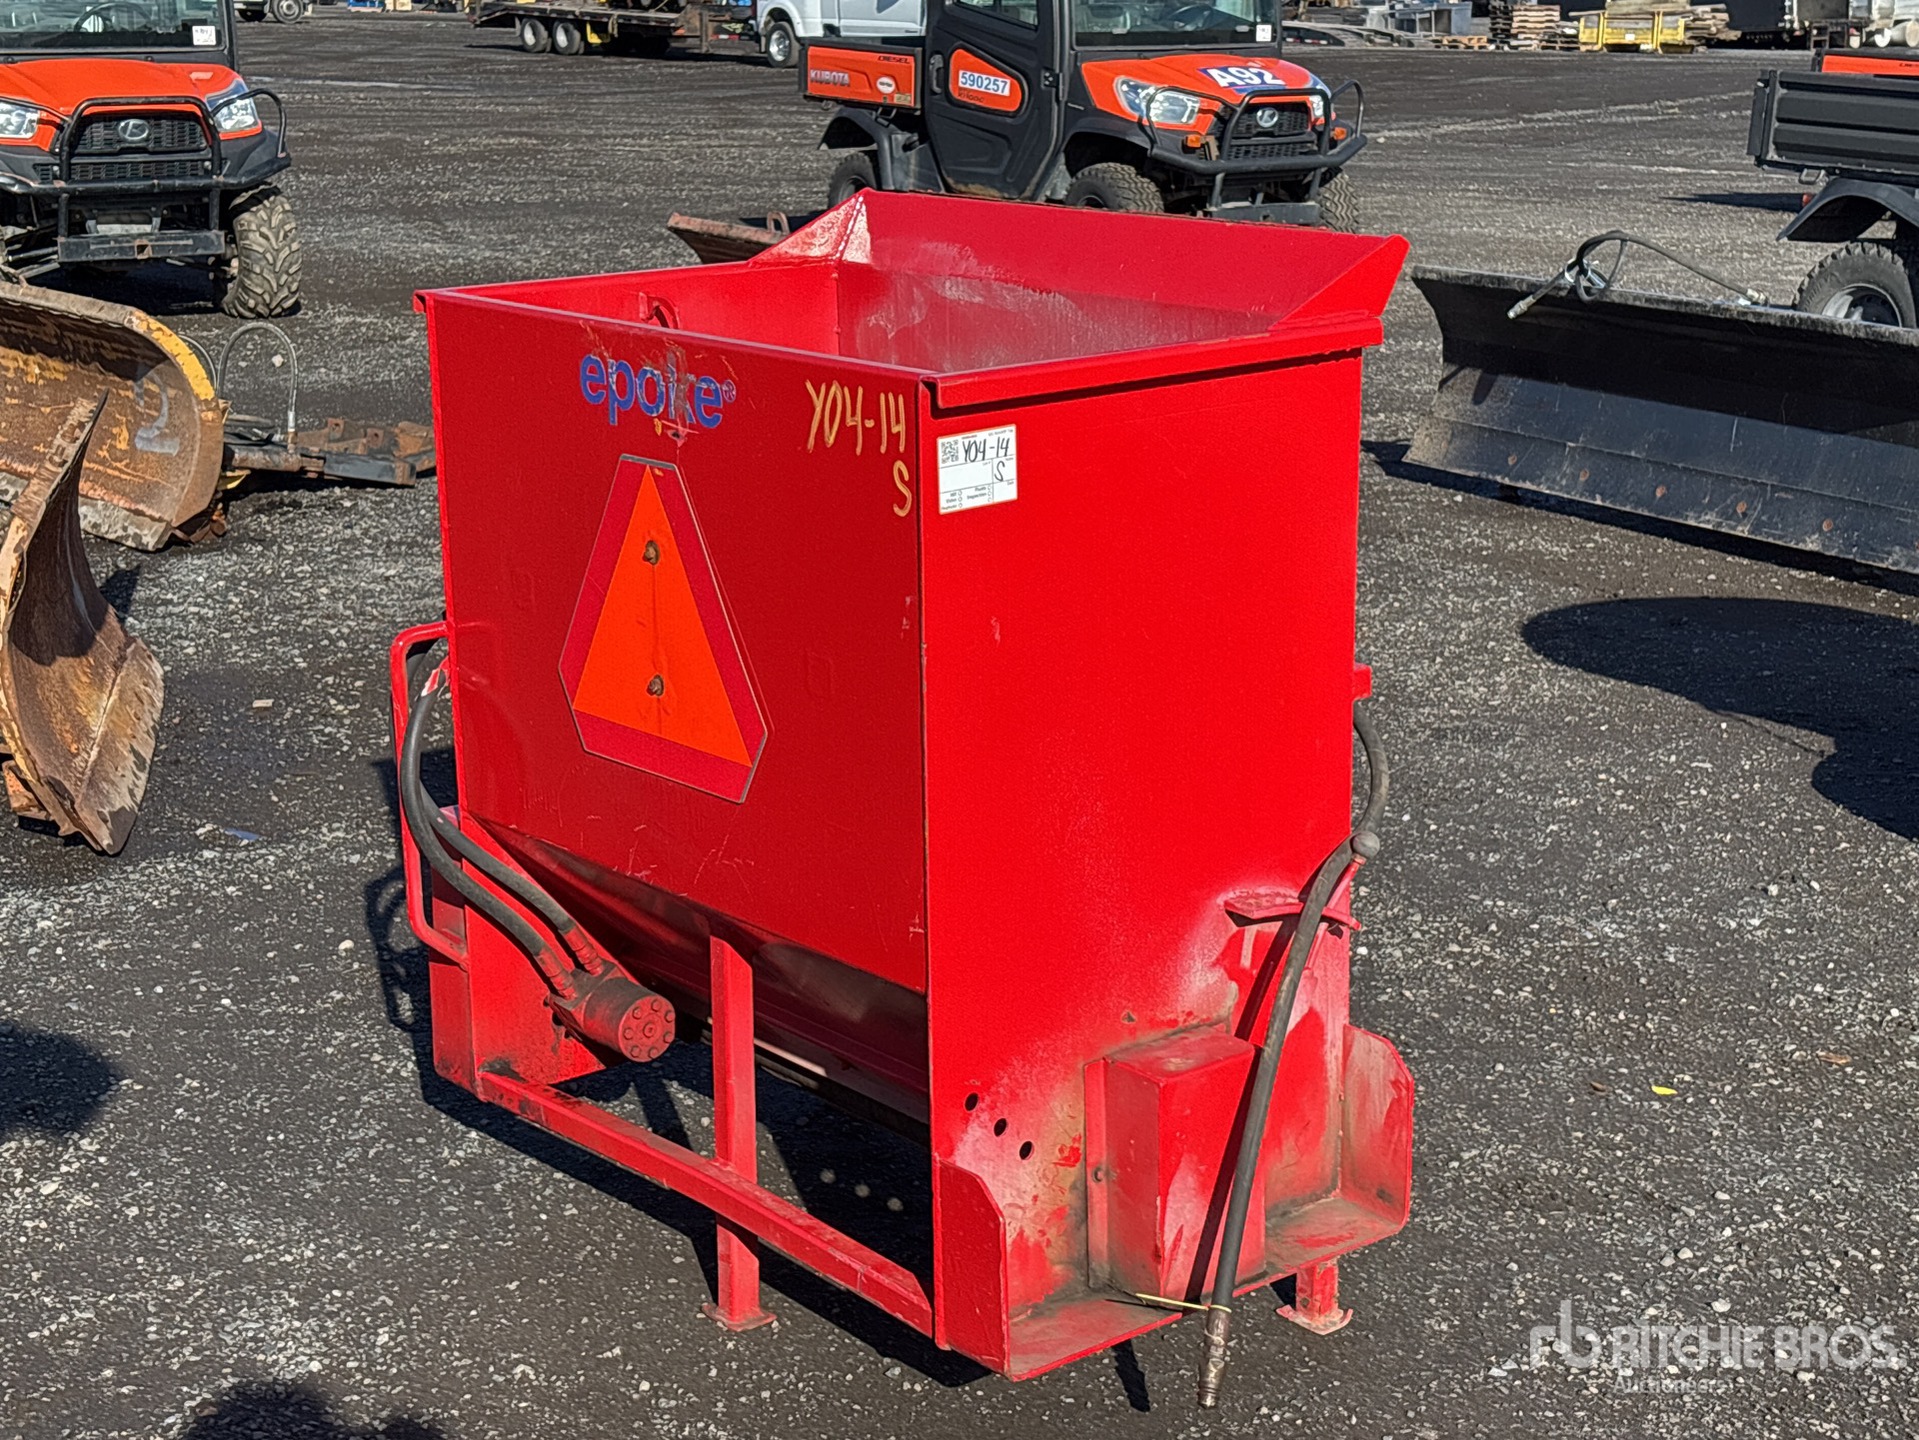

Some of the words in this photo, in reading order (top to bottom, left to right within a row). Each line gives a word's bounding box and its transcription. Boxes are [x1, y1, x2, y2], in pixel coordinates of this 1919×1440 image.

[810, 69, 850, 87] KUBOTA
[960, 72, 1008, 94] 590257
[1207, 67, 1286, 88] A92
[805, 379, 906, 456] Y04-14
[962, 436, 1010, 463] Y04-14
[994, 460, 1006, 482] S
[893, 460, 912, 517] S
